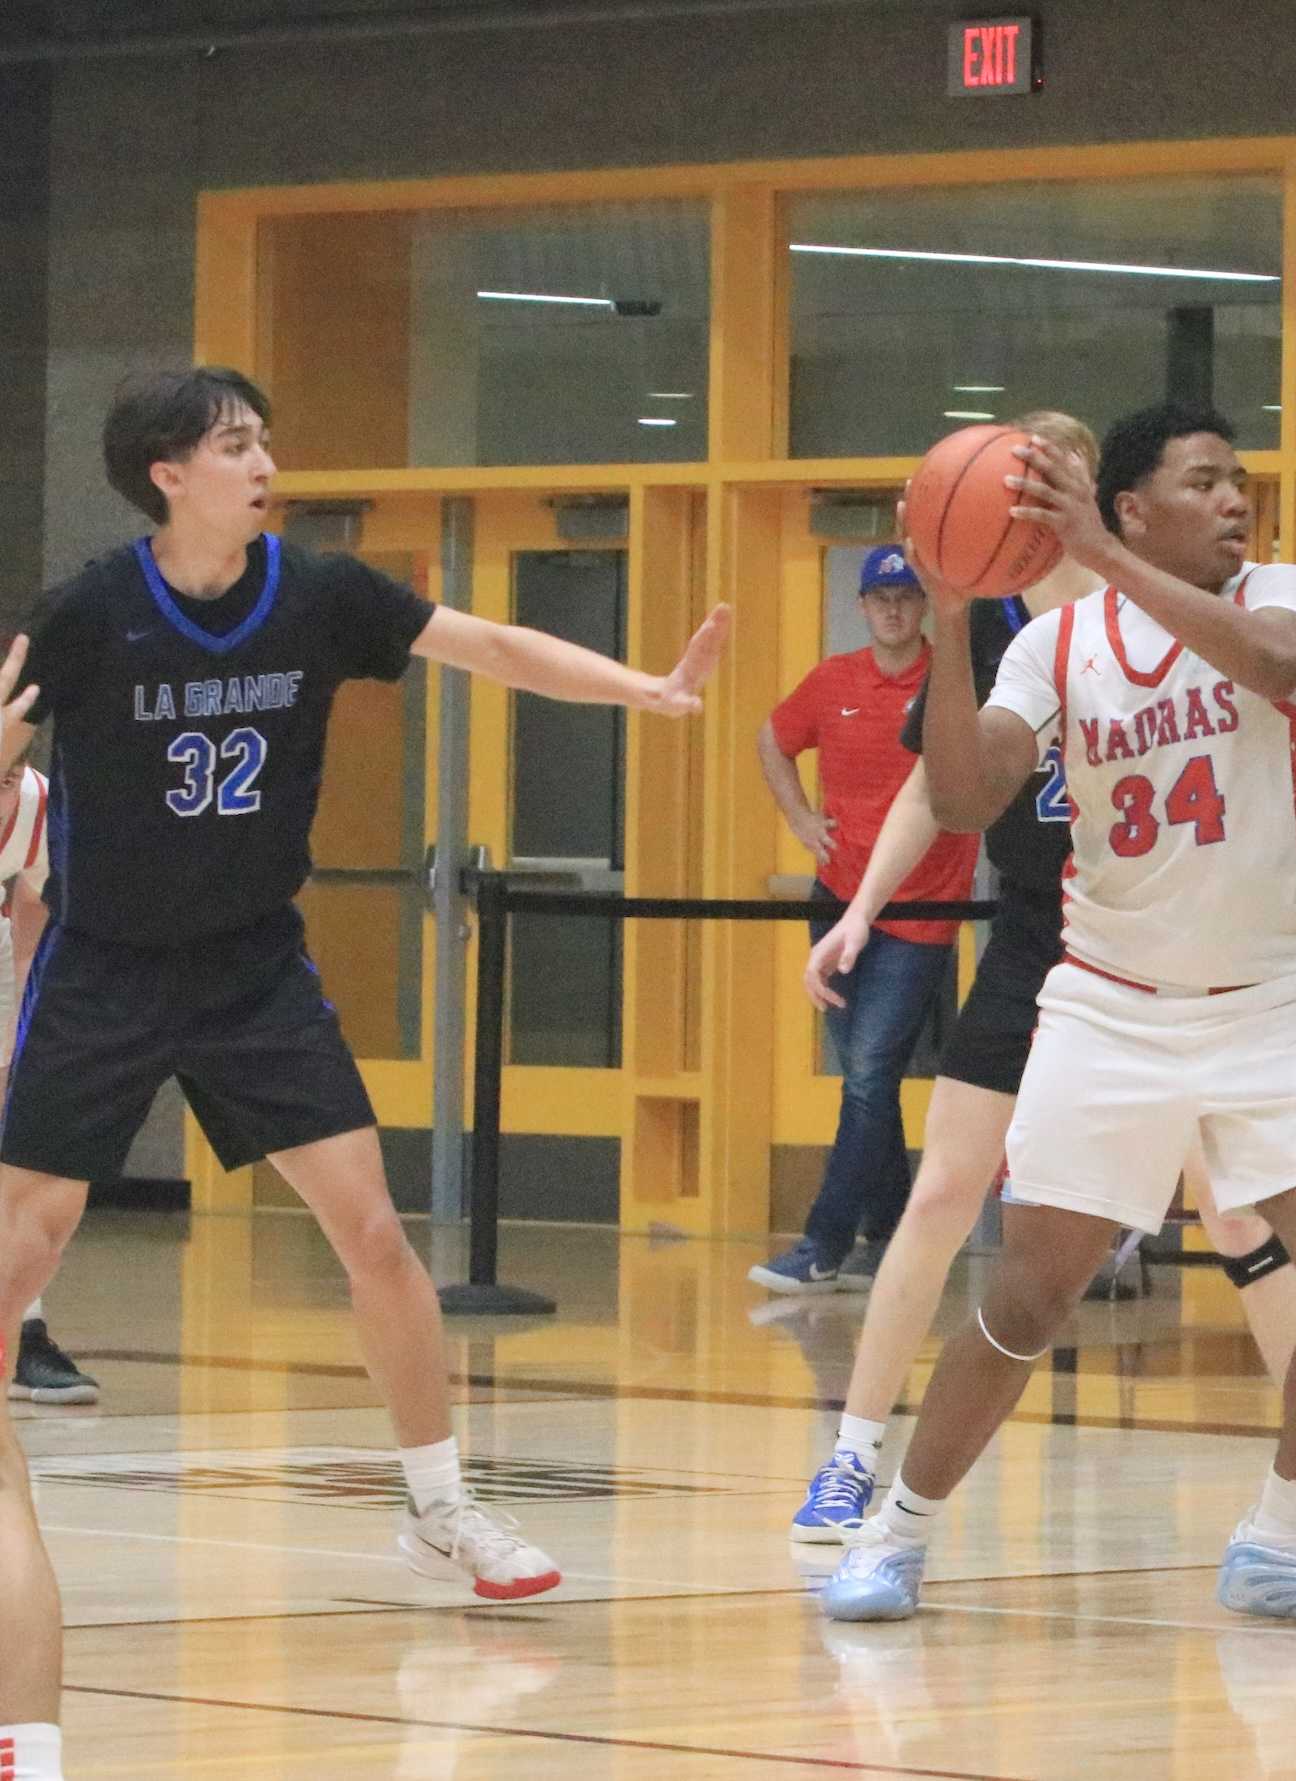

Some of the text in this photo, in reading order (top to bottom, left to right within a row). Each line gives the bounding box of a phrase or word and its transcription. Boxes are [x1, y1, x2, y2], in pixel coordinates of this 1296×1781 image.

[964, 25, 1019, 87] EXIT
[134, 670, 304, 721] LA GRANDE
[1078, 679, 1240, 768] MADRAS
[166, 726, 268, 817] 32
[1108, 754, 1227, 858] 34
